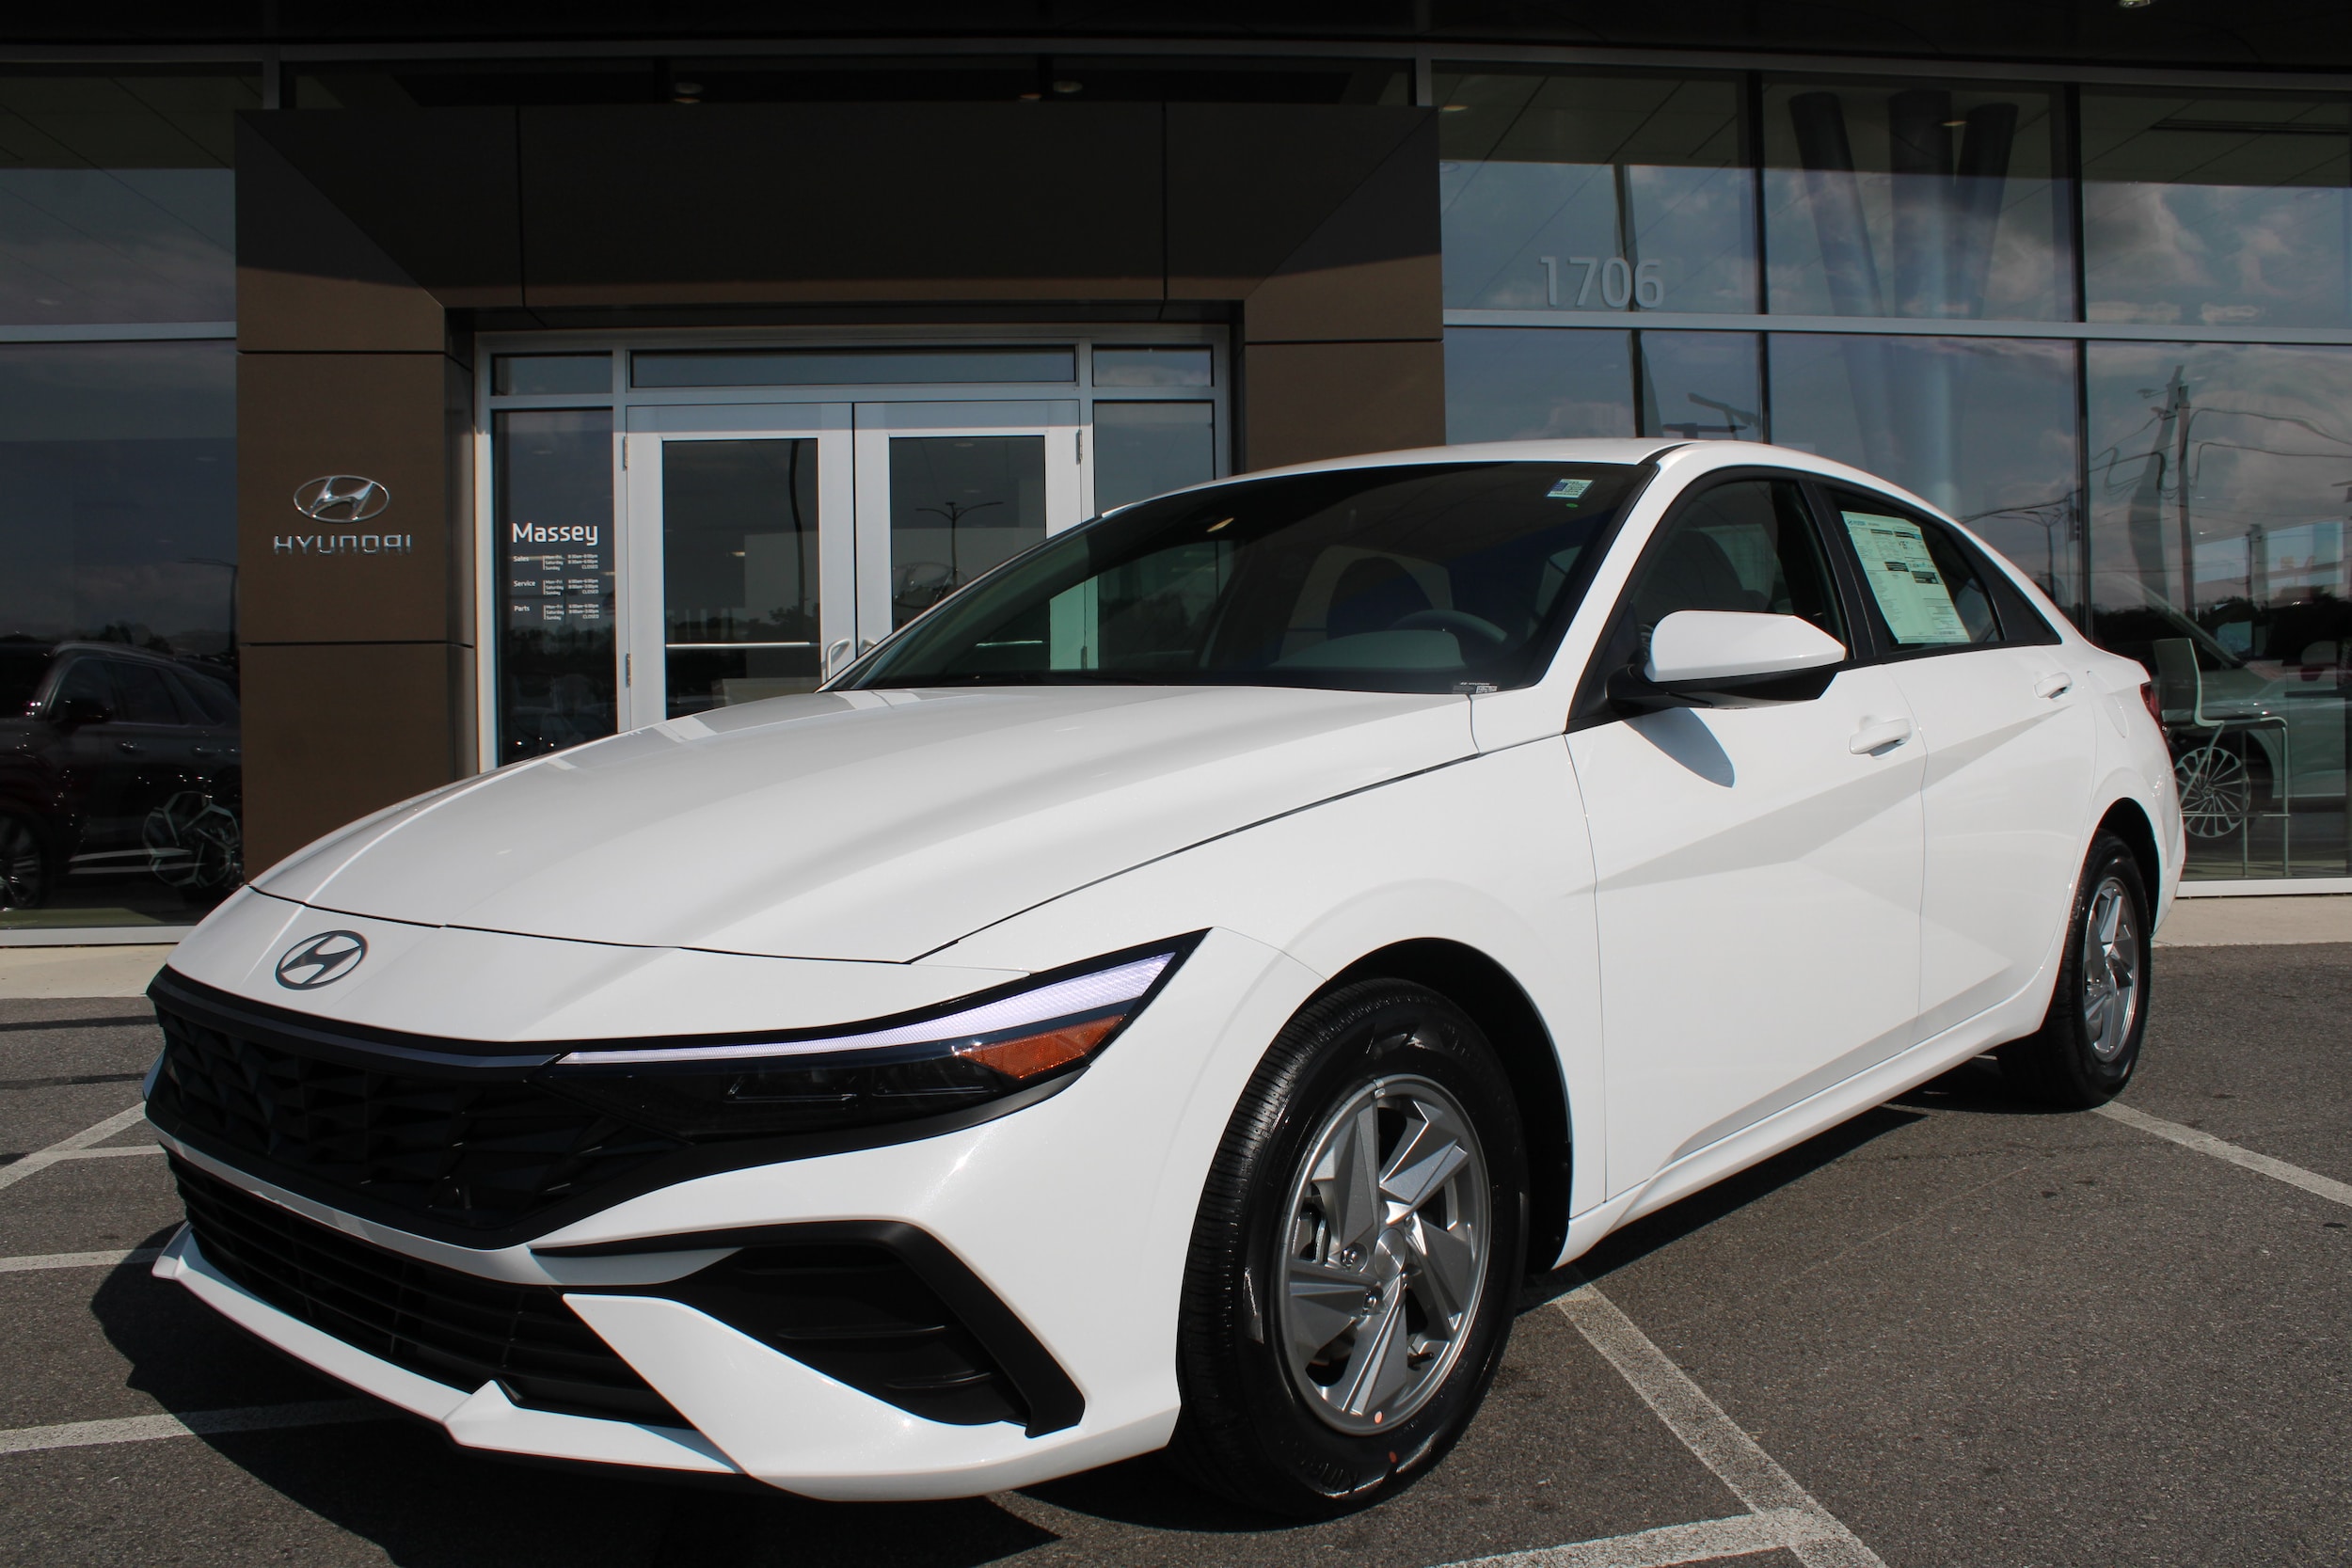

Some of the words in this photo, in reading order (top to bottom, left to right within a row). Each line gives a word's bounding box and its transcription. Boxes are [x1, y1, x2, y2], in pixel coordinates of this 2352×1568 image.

[1539, 256, 1664, 309] 1706
[274, 533, 411, 555] HYUNDAI
[512, 522, 598, 546] Massey
